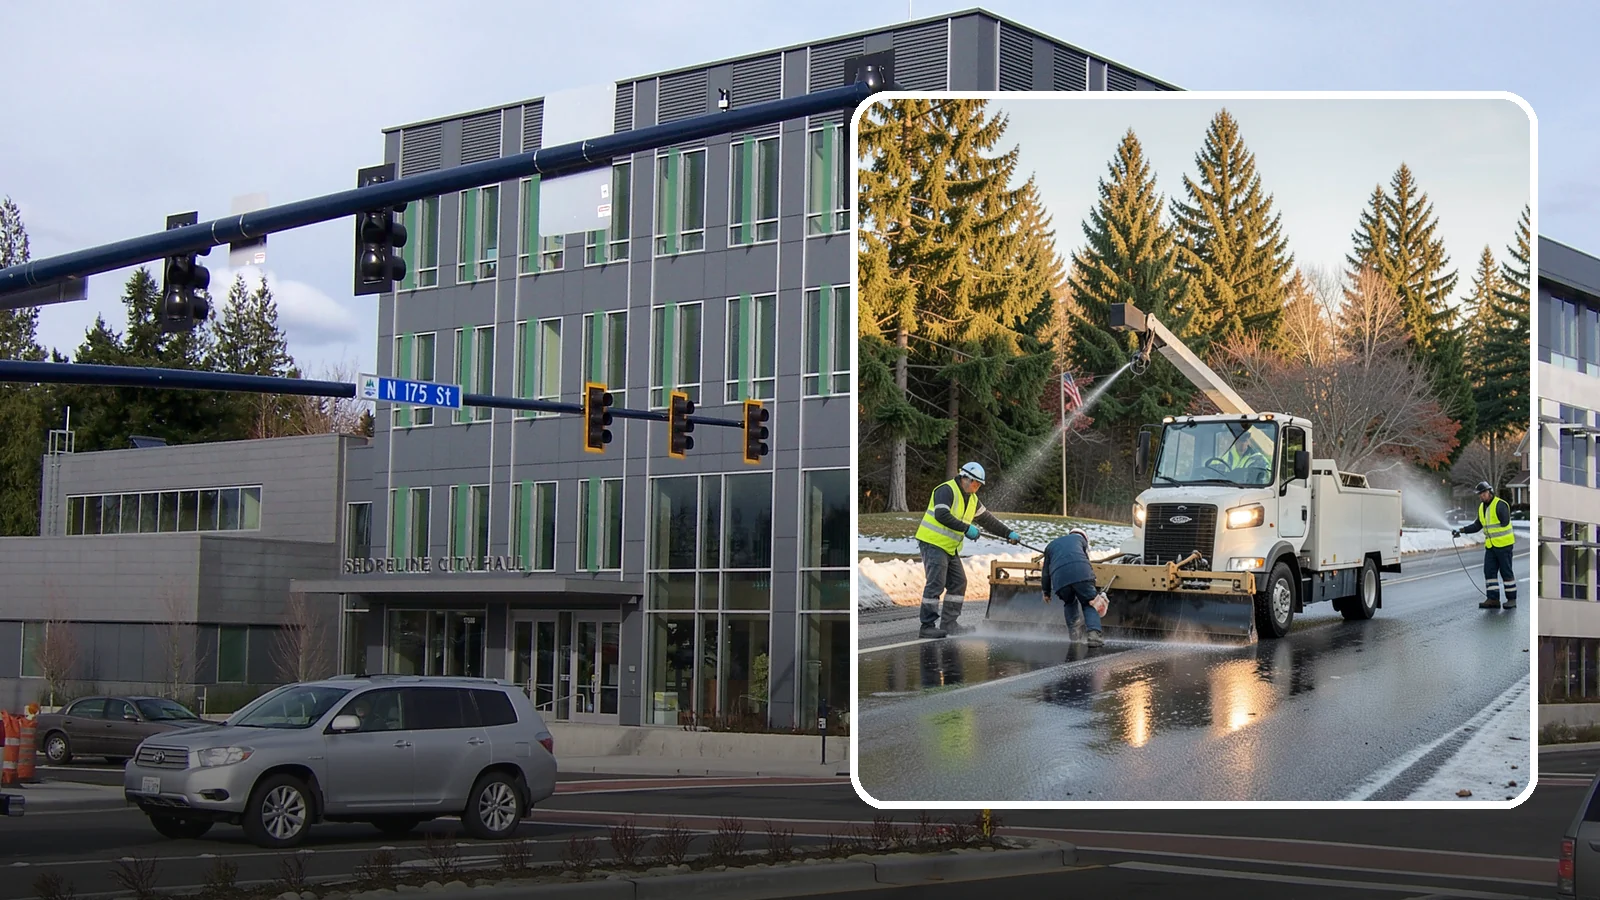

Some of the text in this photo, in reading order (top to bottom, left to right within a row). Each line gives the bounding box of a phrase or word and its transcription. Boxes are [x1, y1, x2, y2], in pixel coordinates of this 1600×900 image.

[387, 380, 451, 406] N 175 St
[344, 555, 526, 574] SHORELINE CITY HALL
